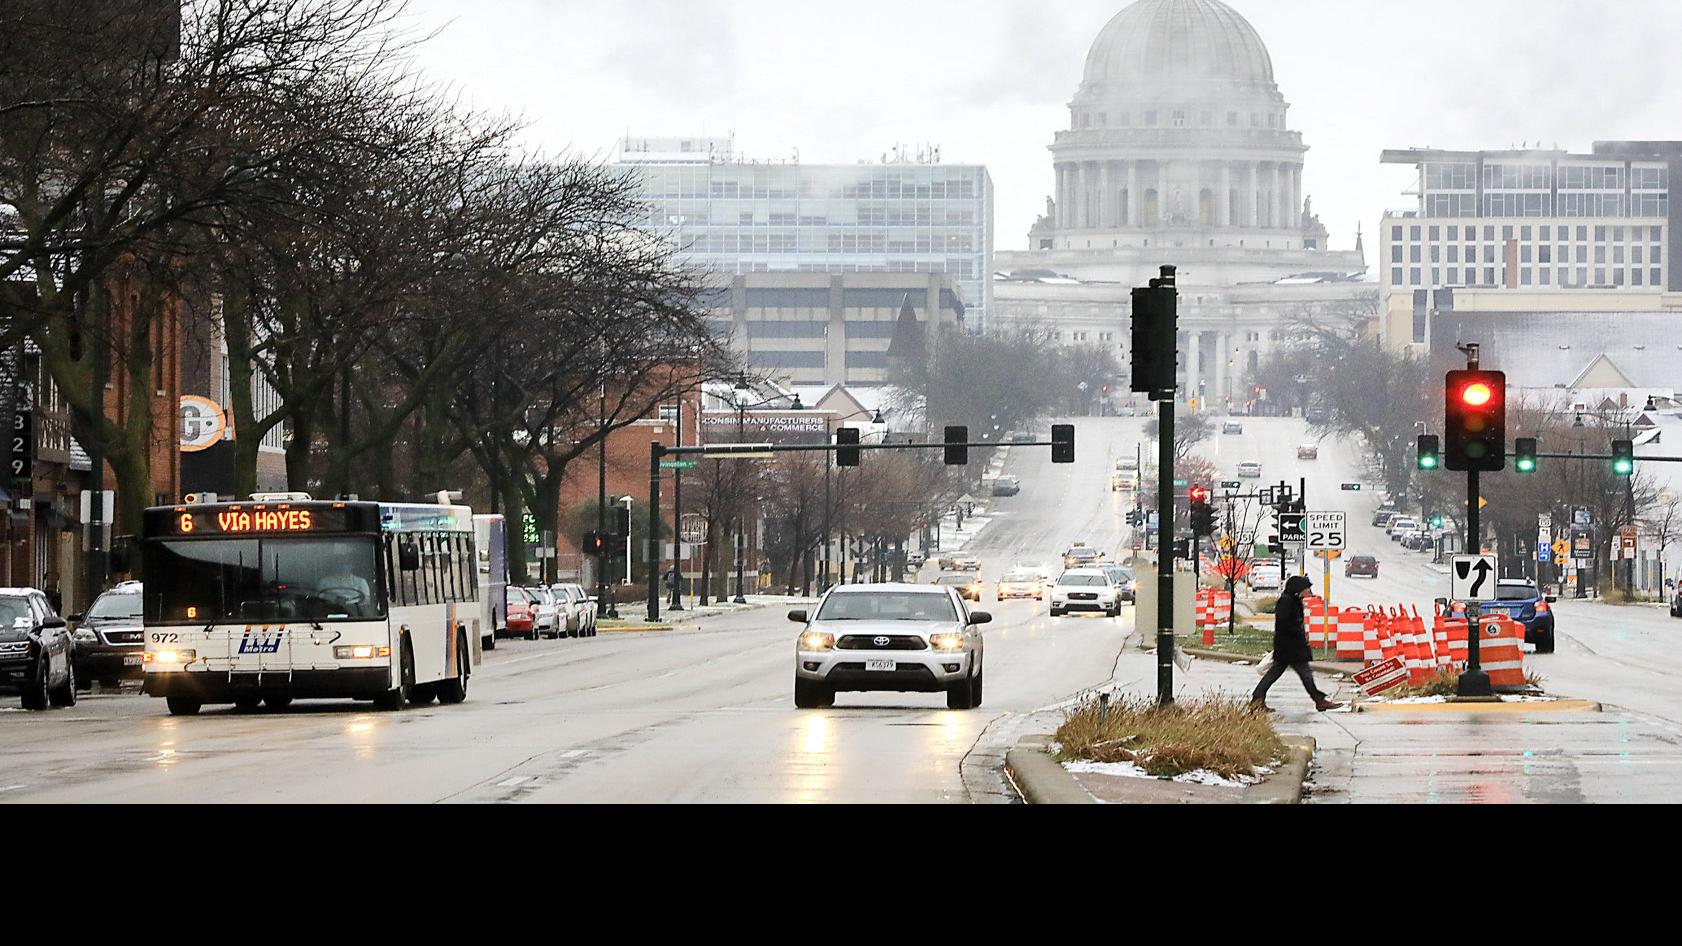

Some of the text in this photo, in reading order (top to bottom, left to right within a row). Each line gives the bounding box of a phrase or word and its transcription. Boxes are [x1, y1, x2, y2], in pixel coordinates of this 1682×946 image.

[742, 417, 824, 425] MANUFACTURERS
[660, 461, 686, 469] ivingston
[181, 511, 311, 532] 6 VIA HAYES
[1310, 532, 1342, 546] 25
[1541, 543, 1549, 551] H
[188, 606, 197, 618] 6
[151, 633, 178, 644] 972
[244, 645, 274, 654] Metro
